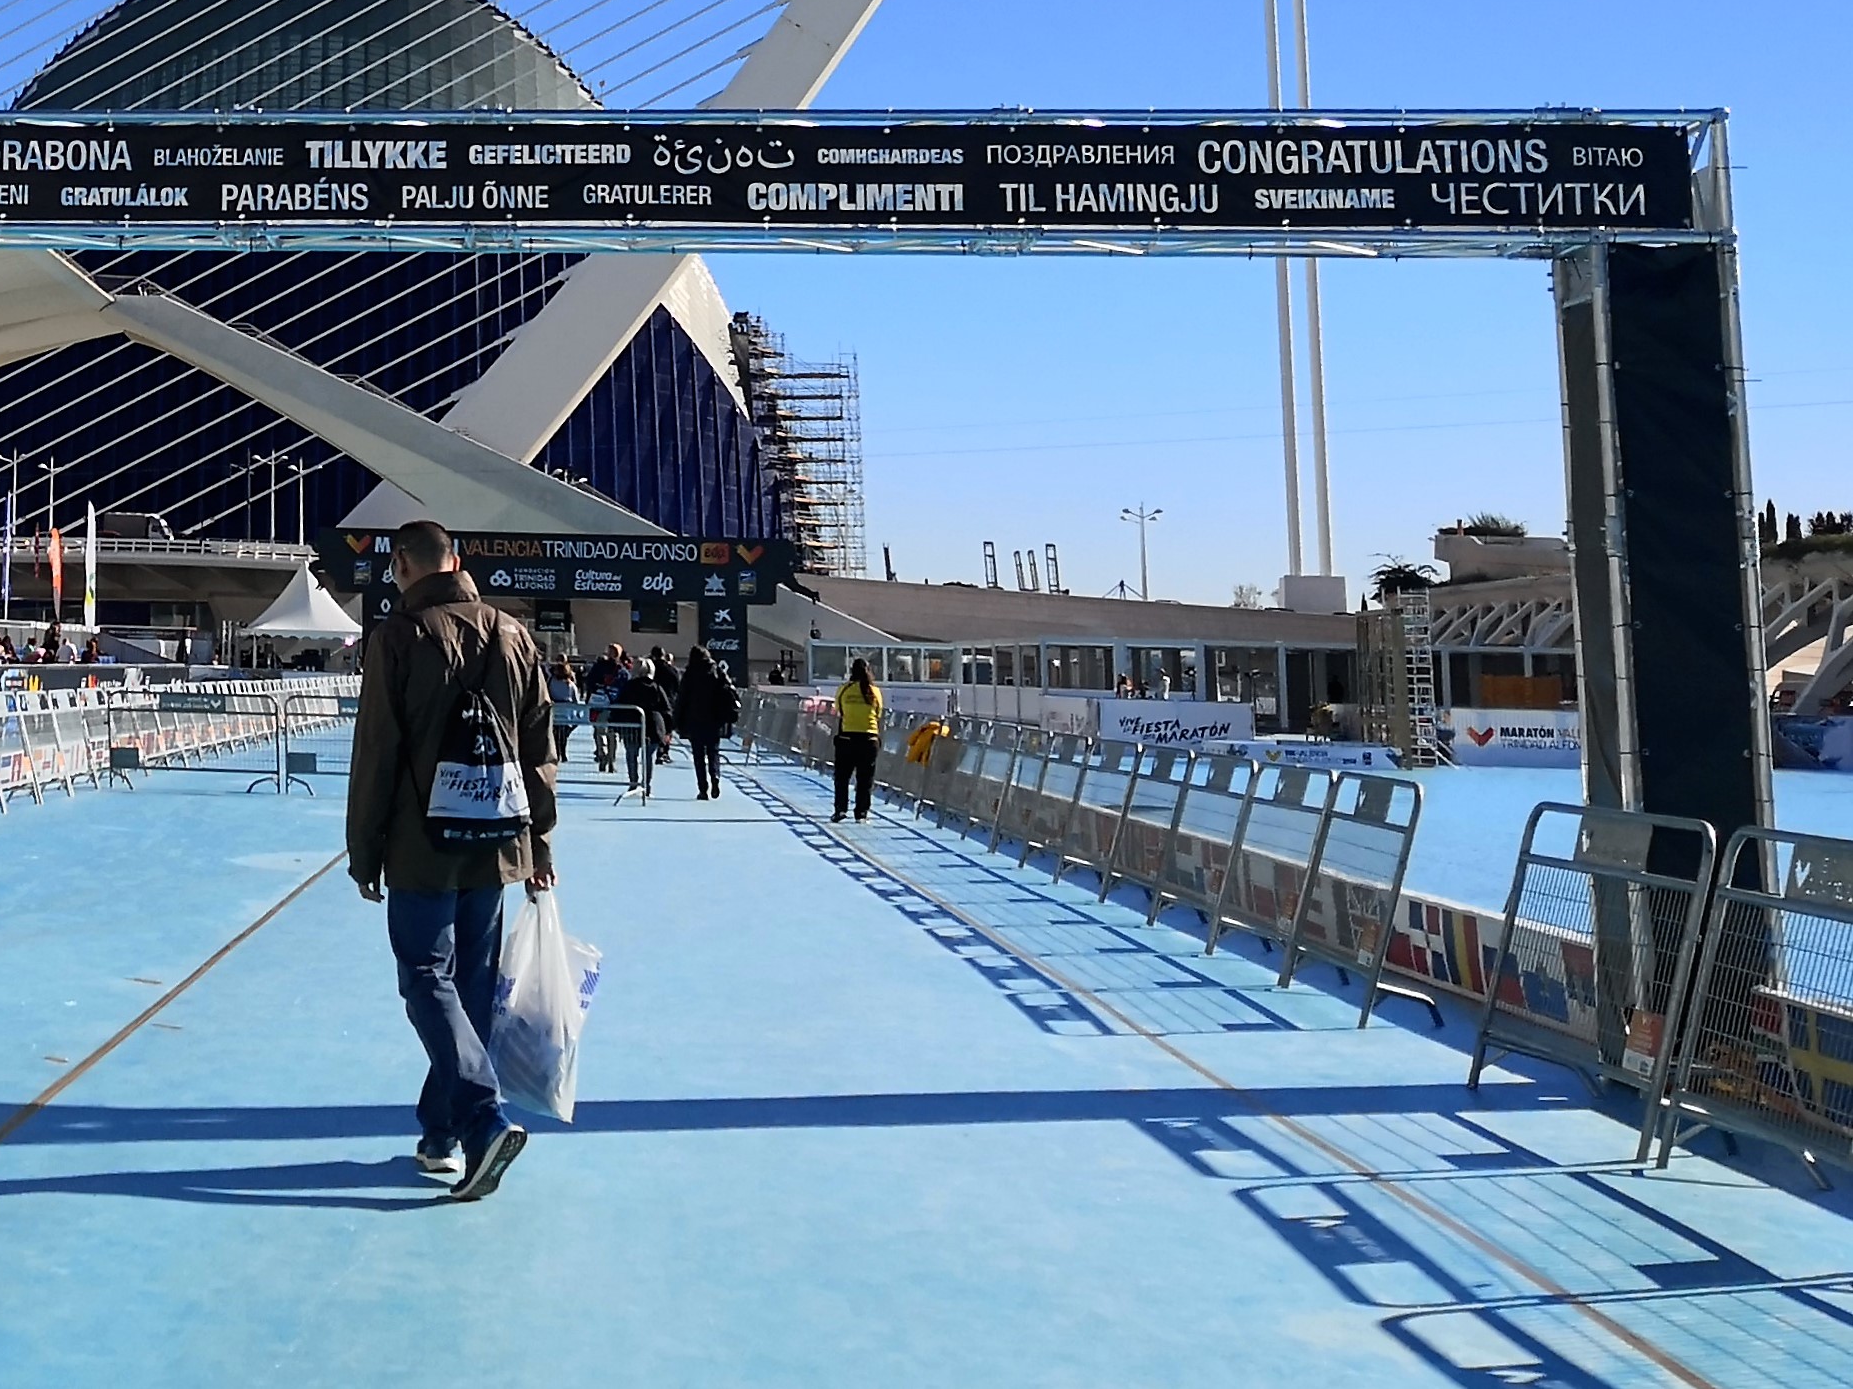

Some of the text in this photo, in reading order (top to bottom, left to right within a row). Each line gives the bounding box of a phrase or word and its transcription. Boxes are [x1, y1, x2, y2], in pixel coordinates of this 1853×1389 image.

[154, 145, 283, 166] BLAHOŽELANIE
[305, 141, 447, 168] TILLYKKE
[469, 144, 630, 164] GEFELICITEERD
[818, 149, 963, 164] COMHGHAIRDEAS
[987, 145, 1174, 167] ПОЗДРАВЛЕНИЯ
[1198, 139, 1548, 174] CONGRATULATIONS
[61, 183, 188, 206] GRATULÁLOK
[222, 177, 368, 211] PARABÉNS
[402, 181, 548, 208] PALJU ÕNNE
[584, 184, 711, 205] GRATULERER
[748, 183, 963, 211] COMPLIMENTI
[999, 184, 1218, 213] TIL HAMINGJU
[1255, 189, 1394, 209] SVEIKINAME
[1431, 183, 1645, 215] ЧЕСТИТКИ
[462, 539, 542, 557] VALENCIA
[542, 540, 618, 559] TRINIDAD
[620, 542, 698, 561] ALFONSO
[514, 582, 556, 591] ALFONSO
[574, 580, 622, 592] Esfuerzo
[1131, 719, 1181, 736] FIESTA
[1155, 719, 1232, 745] MARATÓN
[1500, 725, 1554, 738] MARATÓN
